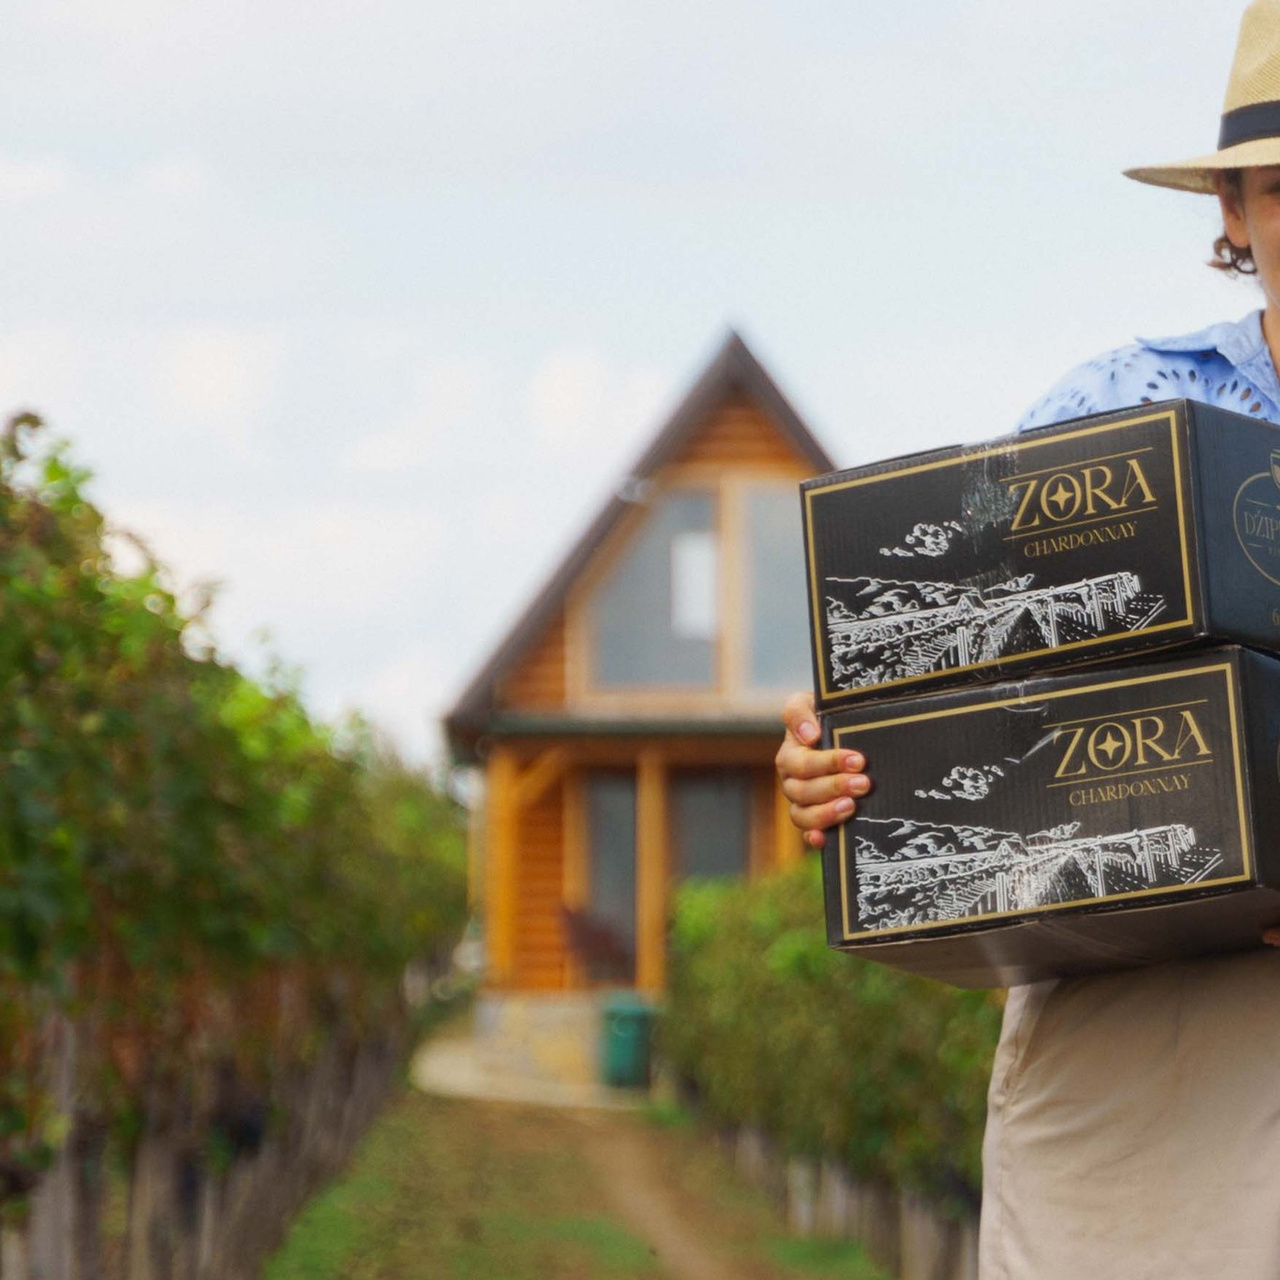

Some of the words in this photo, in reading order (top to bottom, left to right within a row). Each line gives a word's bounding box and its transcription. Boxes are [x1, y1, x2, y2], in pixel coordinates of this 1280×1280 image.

[1008, 458, 1157, 531] ZORA
[1023, 521, 1138, 558] CHARDONNAY
[1053, 710, 1213, 778] ZORA
[1068, 773, 1192, 806] CHARDONNAY
